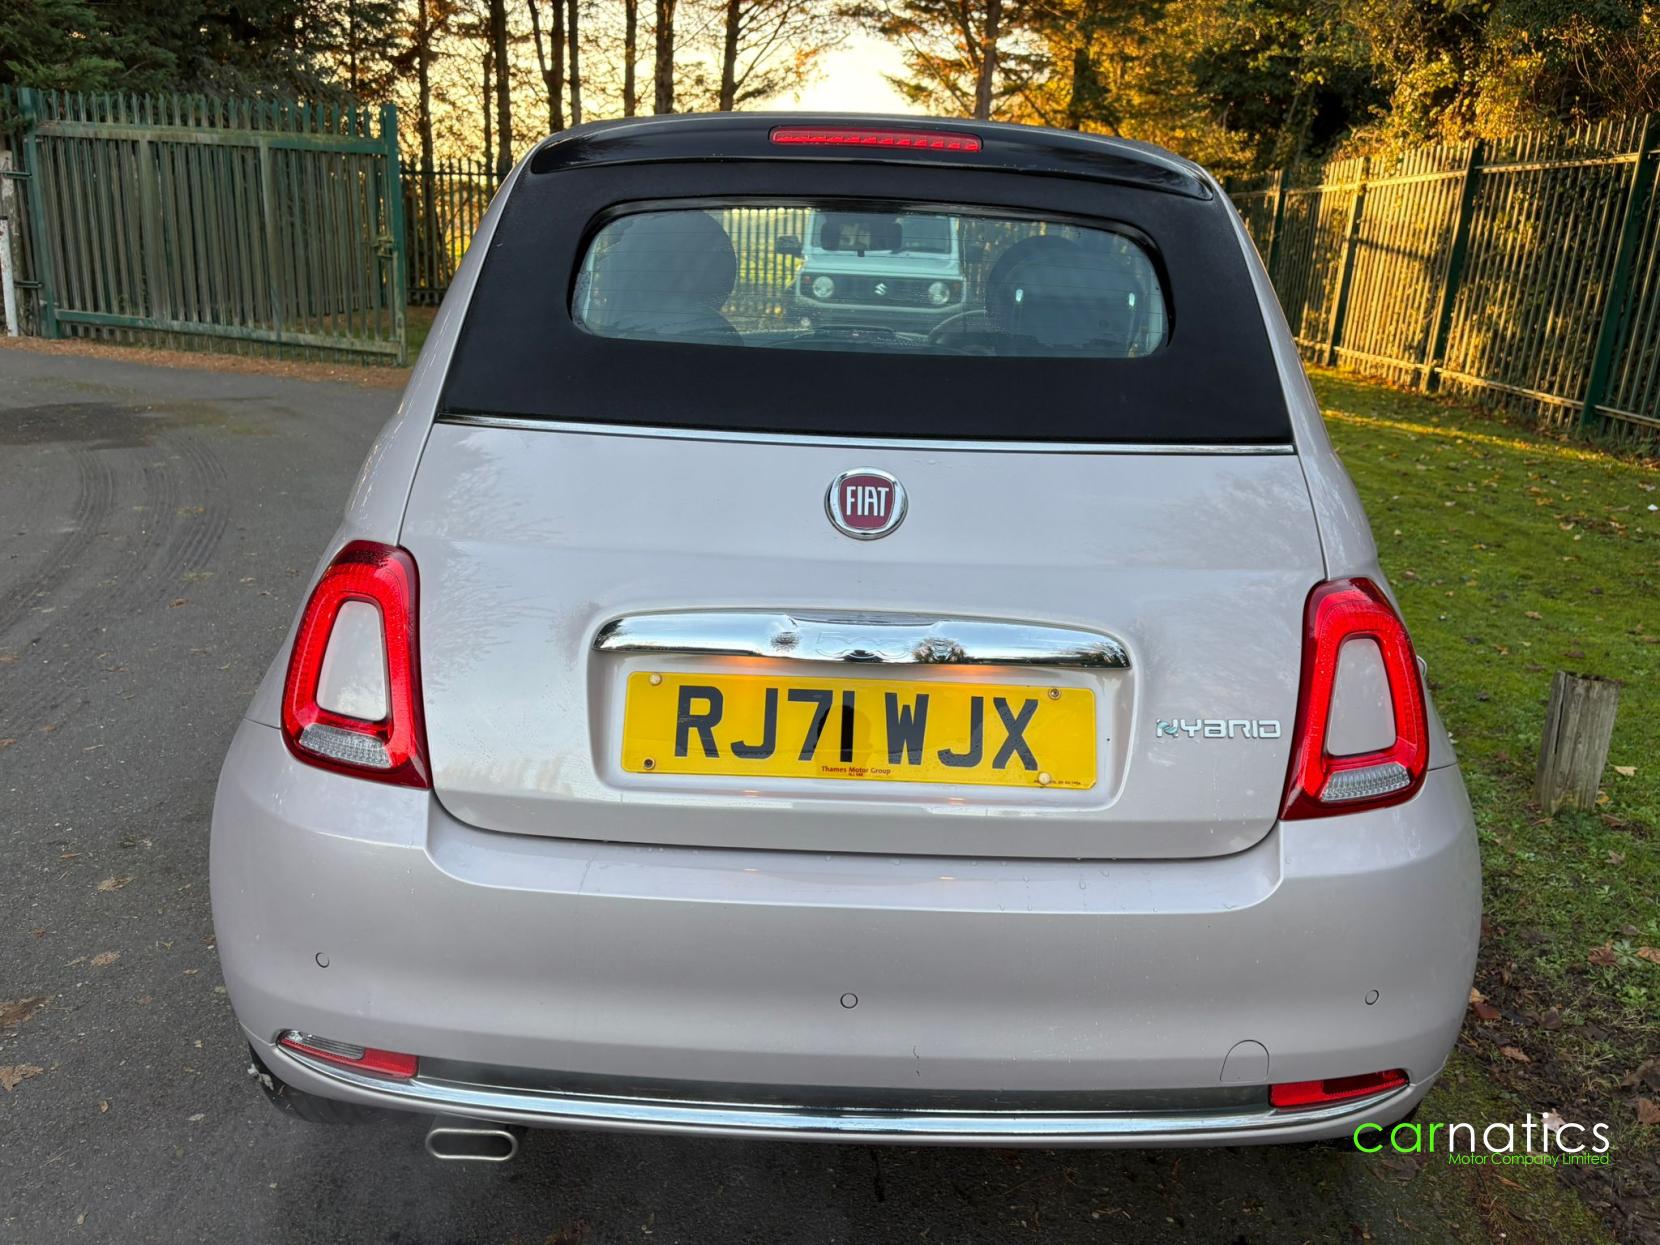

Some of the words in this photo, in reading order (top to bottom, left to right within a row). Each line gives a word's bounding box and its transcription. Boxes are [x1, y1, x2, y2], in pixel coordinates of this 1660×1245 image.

[846, 485, 889, 516] FIAT
[674, 685, 855, 762] RJ71
[884, 692, 1038, 770] WJX
[1156, 719, 1281, 738] HYBRID
[821, 765, 847, 773] Thames
[870, 767, 891, 775] Group
